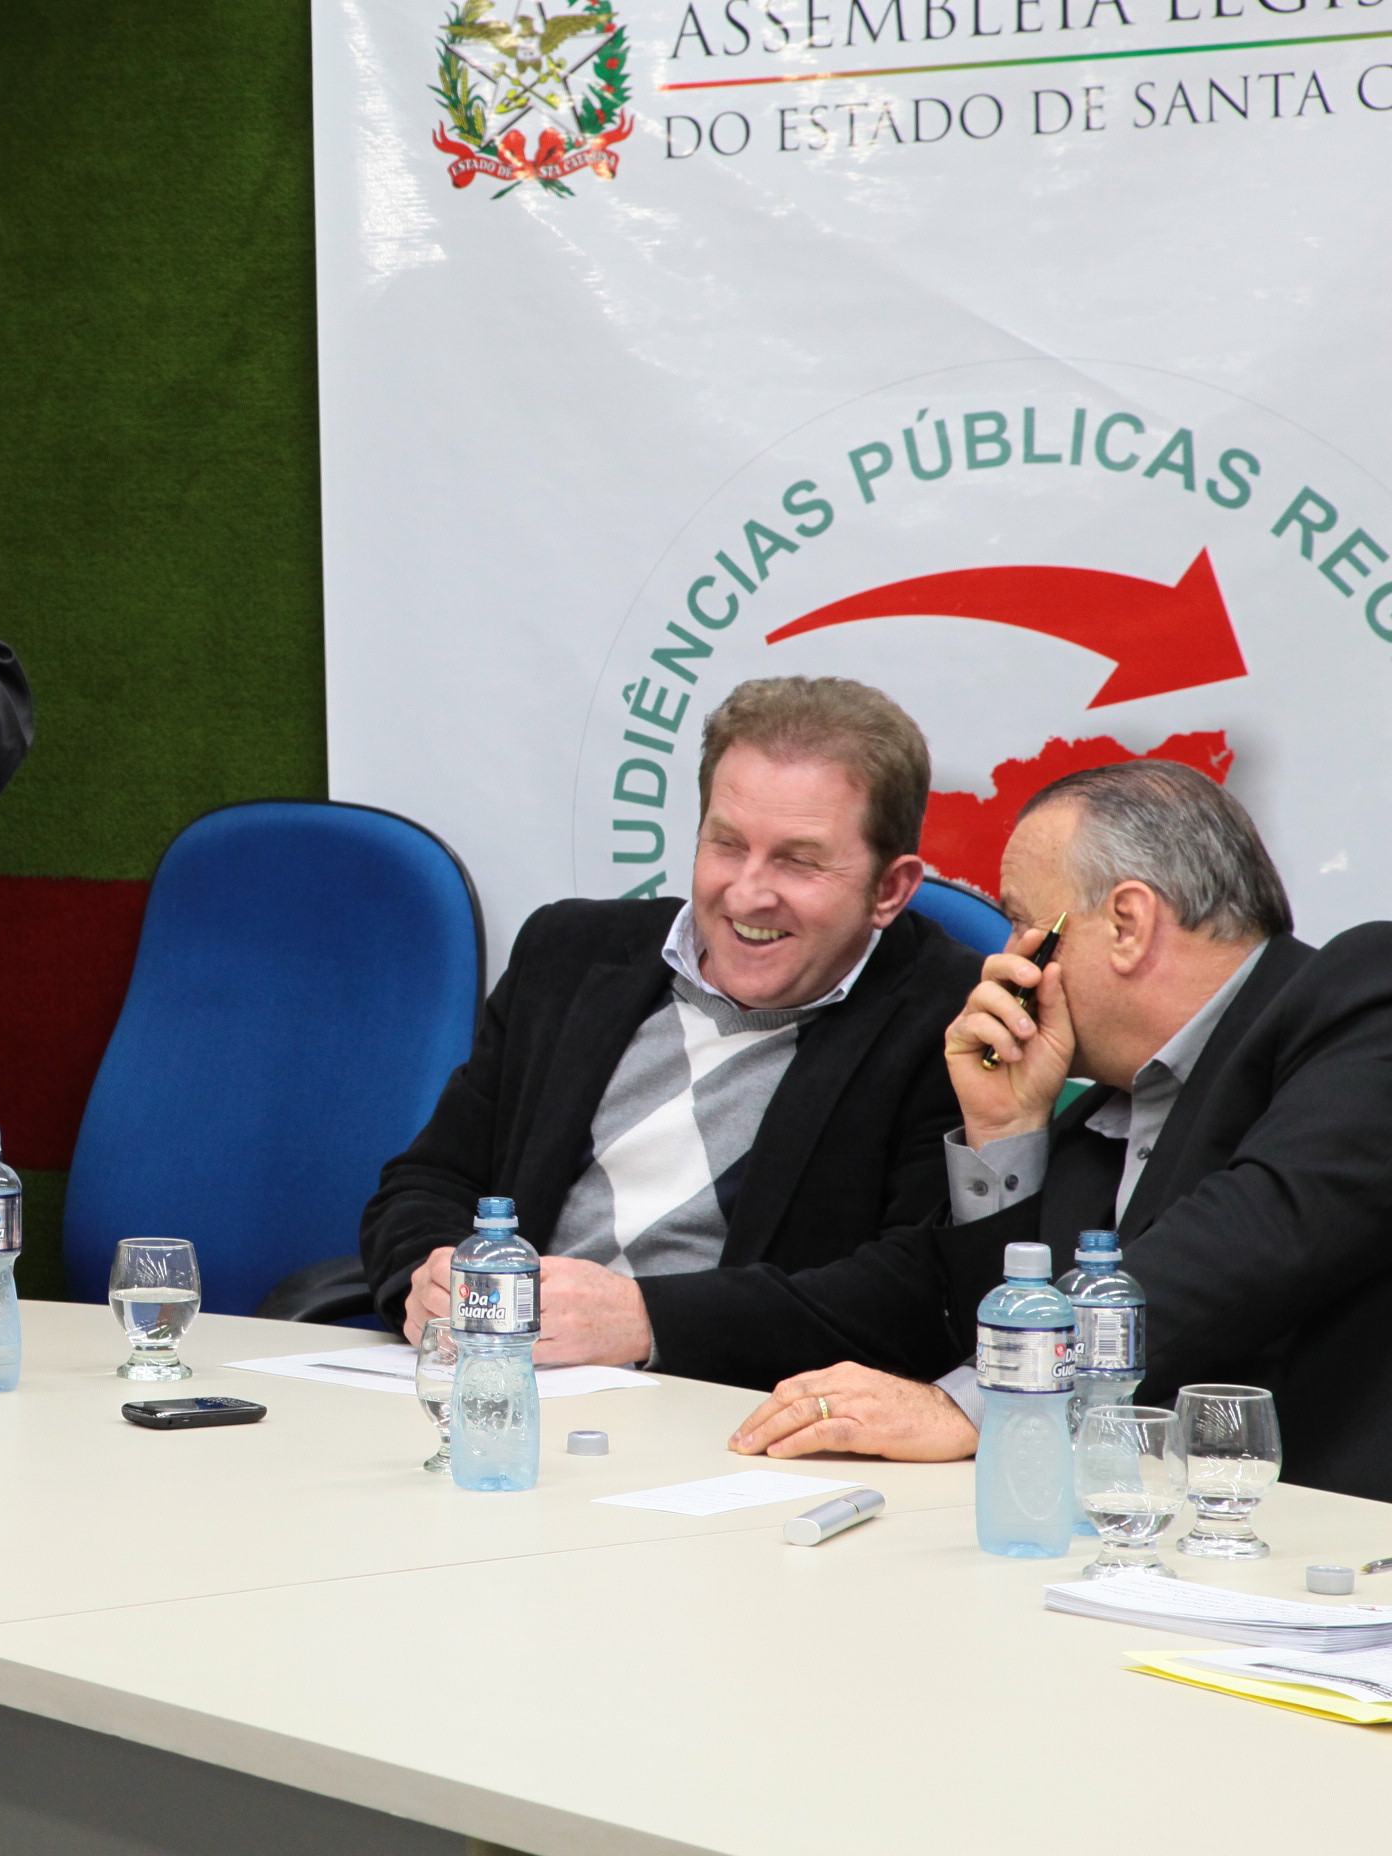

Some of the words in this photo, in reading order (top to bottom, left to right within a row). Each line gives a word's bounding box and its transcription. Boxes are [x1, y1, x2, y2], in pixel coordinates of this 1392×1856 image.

[664, 110, 752, 160] DO
[777, 93, 1005, 153] ESTADO
[1031, 86, 1107, 136] DE
[1133, 69, 1337, 130] SANTA
[611, 480, 836, 900] AUDIÊNCIAS
[847, 405, 1263, 511] PÚBLICAS
[457, 1302, 507, 1320] Guarda
[468, 1291, 489, 1306] Da
